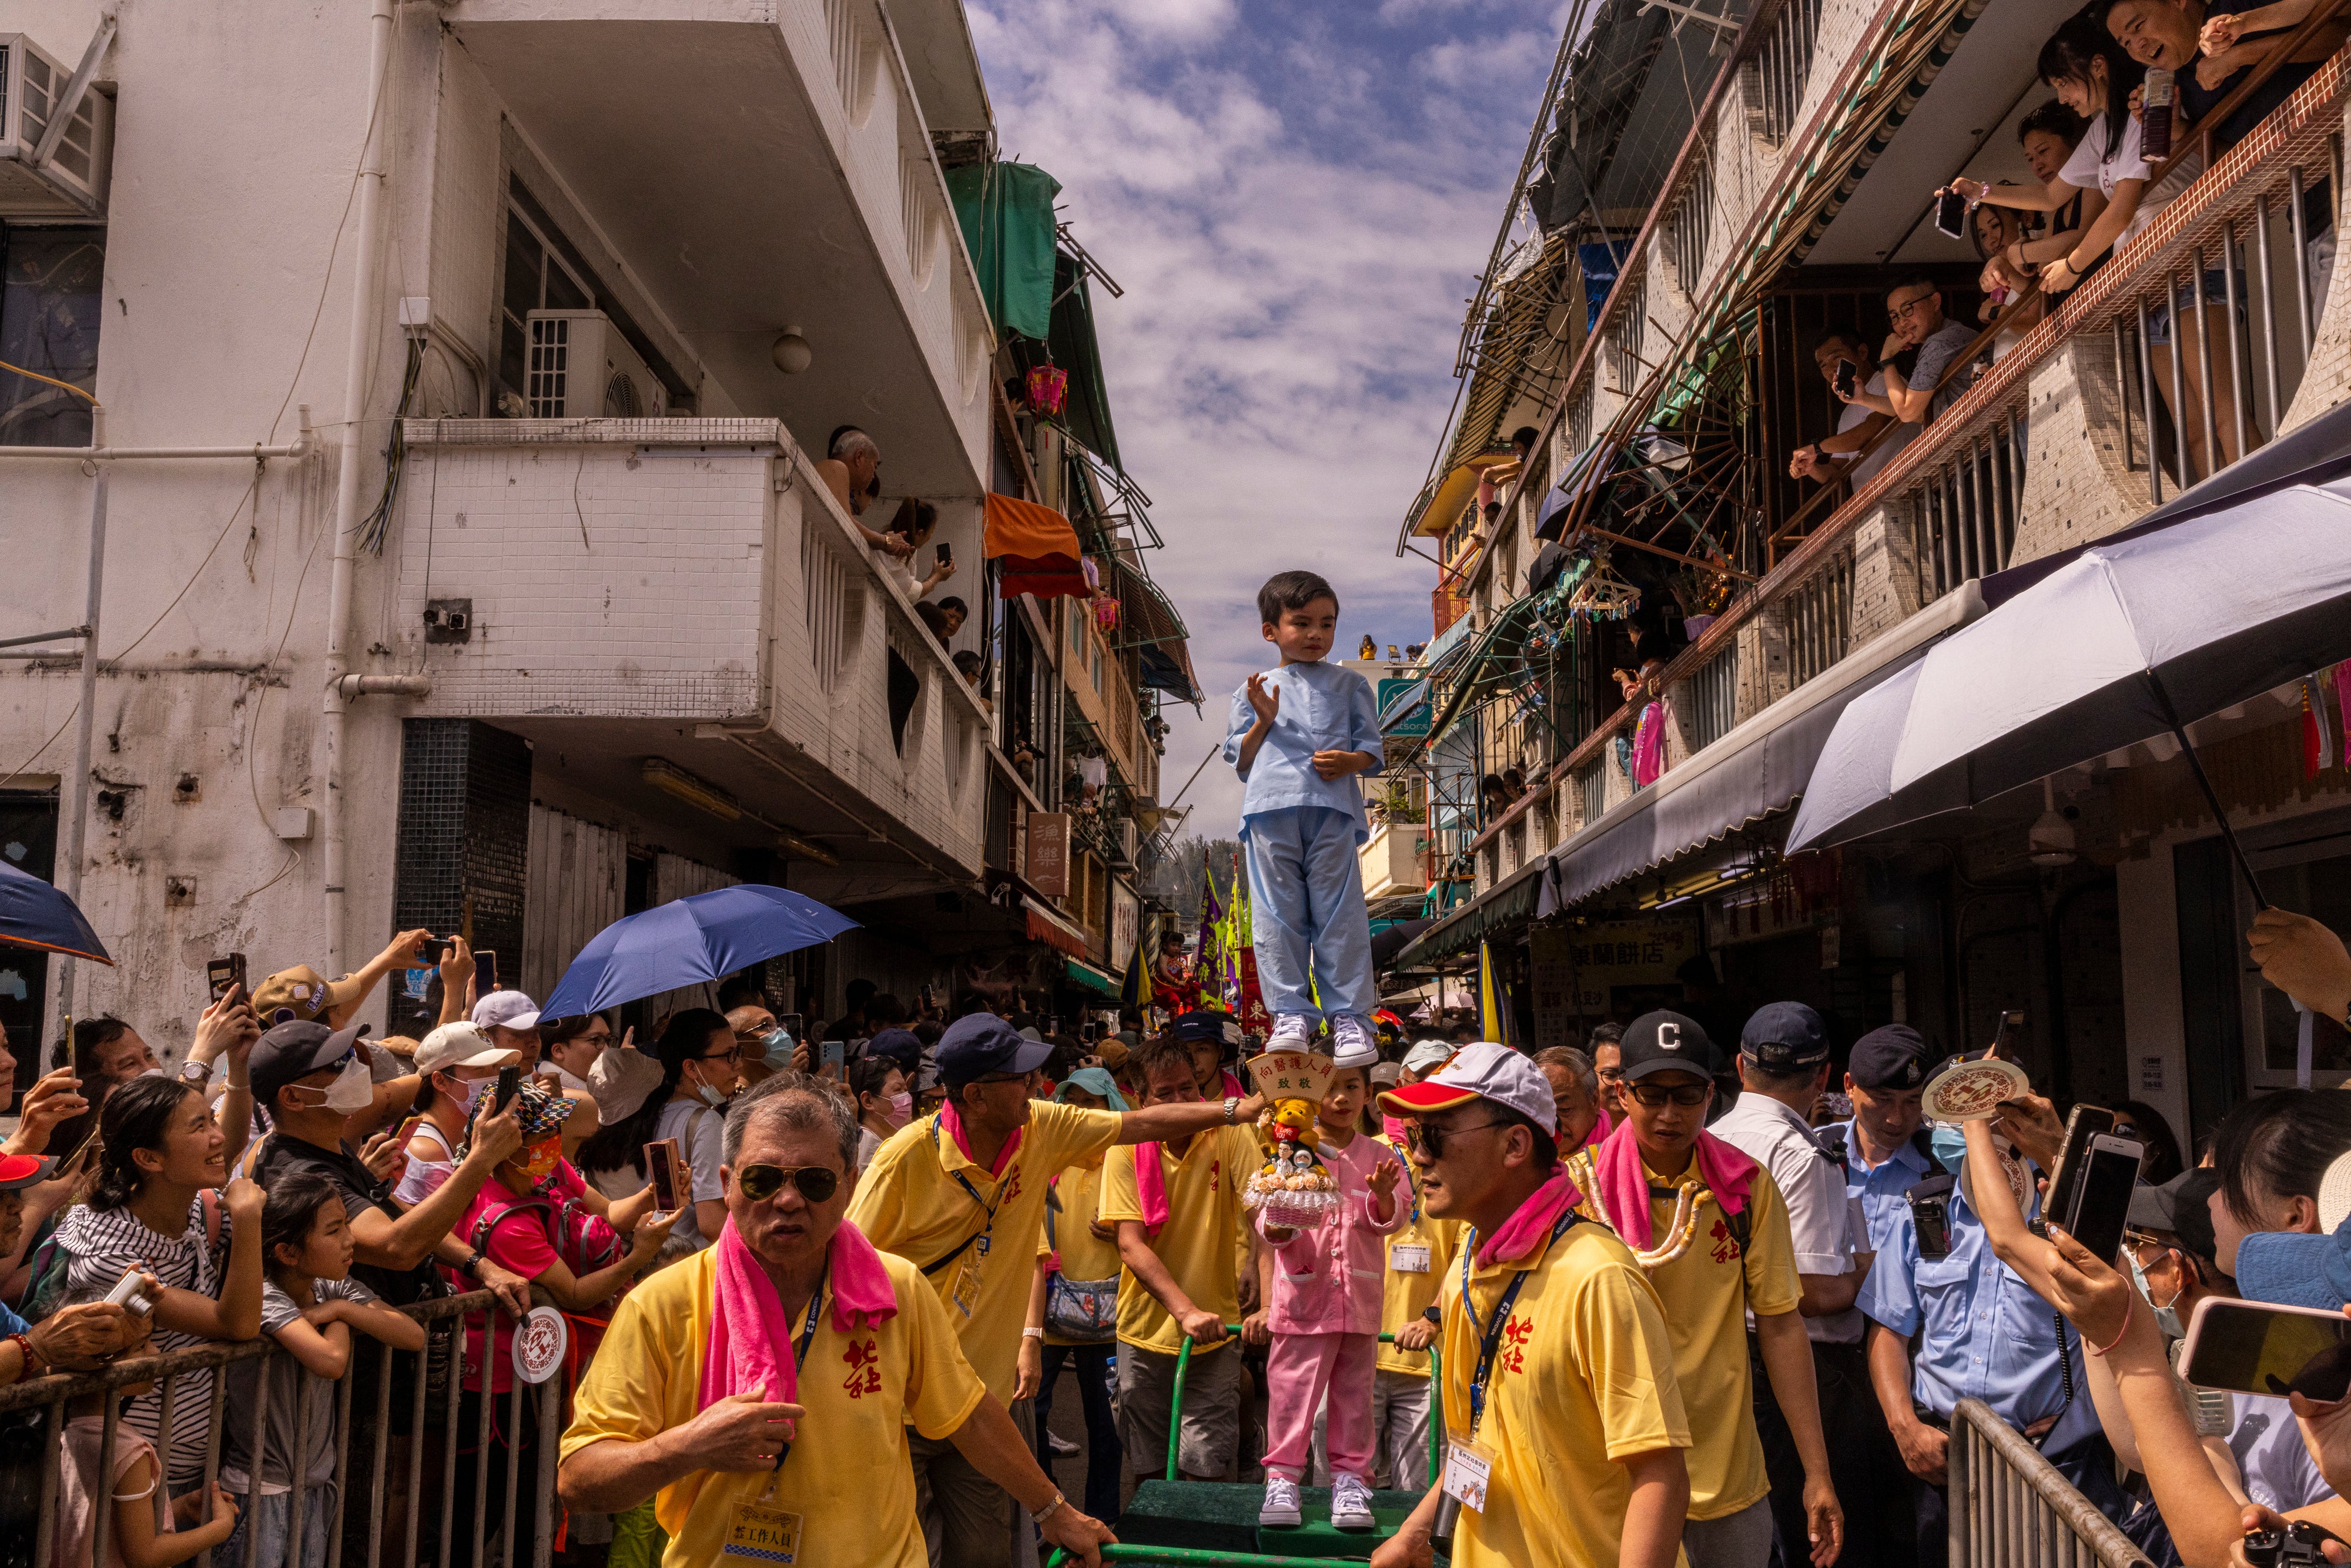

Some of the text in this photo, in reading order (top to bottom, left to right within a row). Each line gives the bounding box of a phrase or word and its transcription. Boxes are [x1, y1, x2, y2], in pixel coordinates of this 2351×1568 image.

[1657, 1023, 1681, 1050] C
[1260, 1056, 1332, 1079] 向醫護人員
[1277, 1077, 1312, 1088] 致敬
[1280, 1127, 1294, 1136] LOVE
[1556, 1216, 1570, 1235] COVIDIEN
[811, 1296, 819, 1319] COVIDIEN
[1491, 1314, 1503, 1336] COVIDIEN
[748, 1528, 791, 1548] 工作人員
